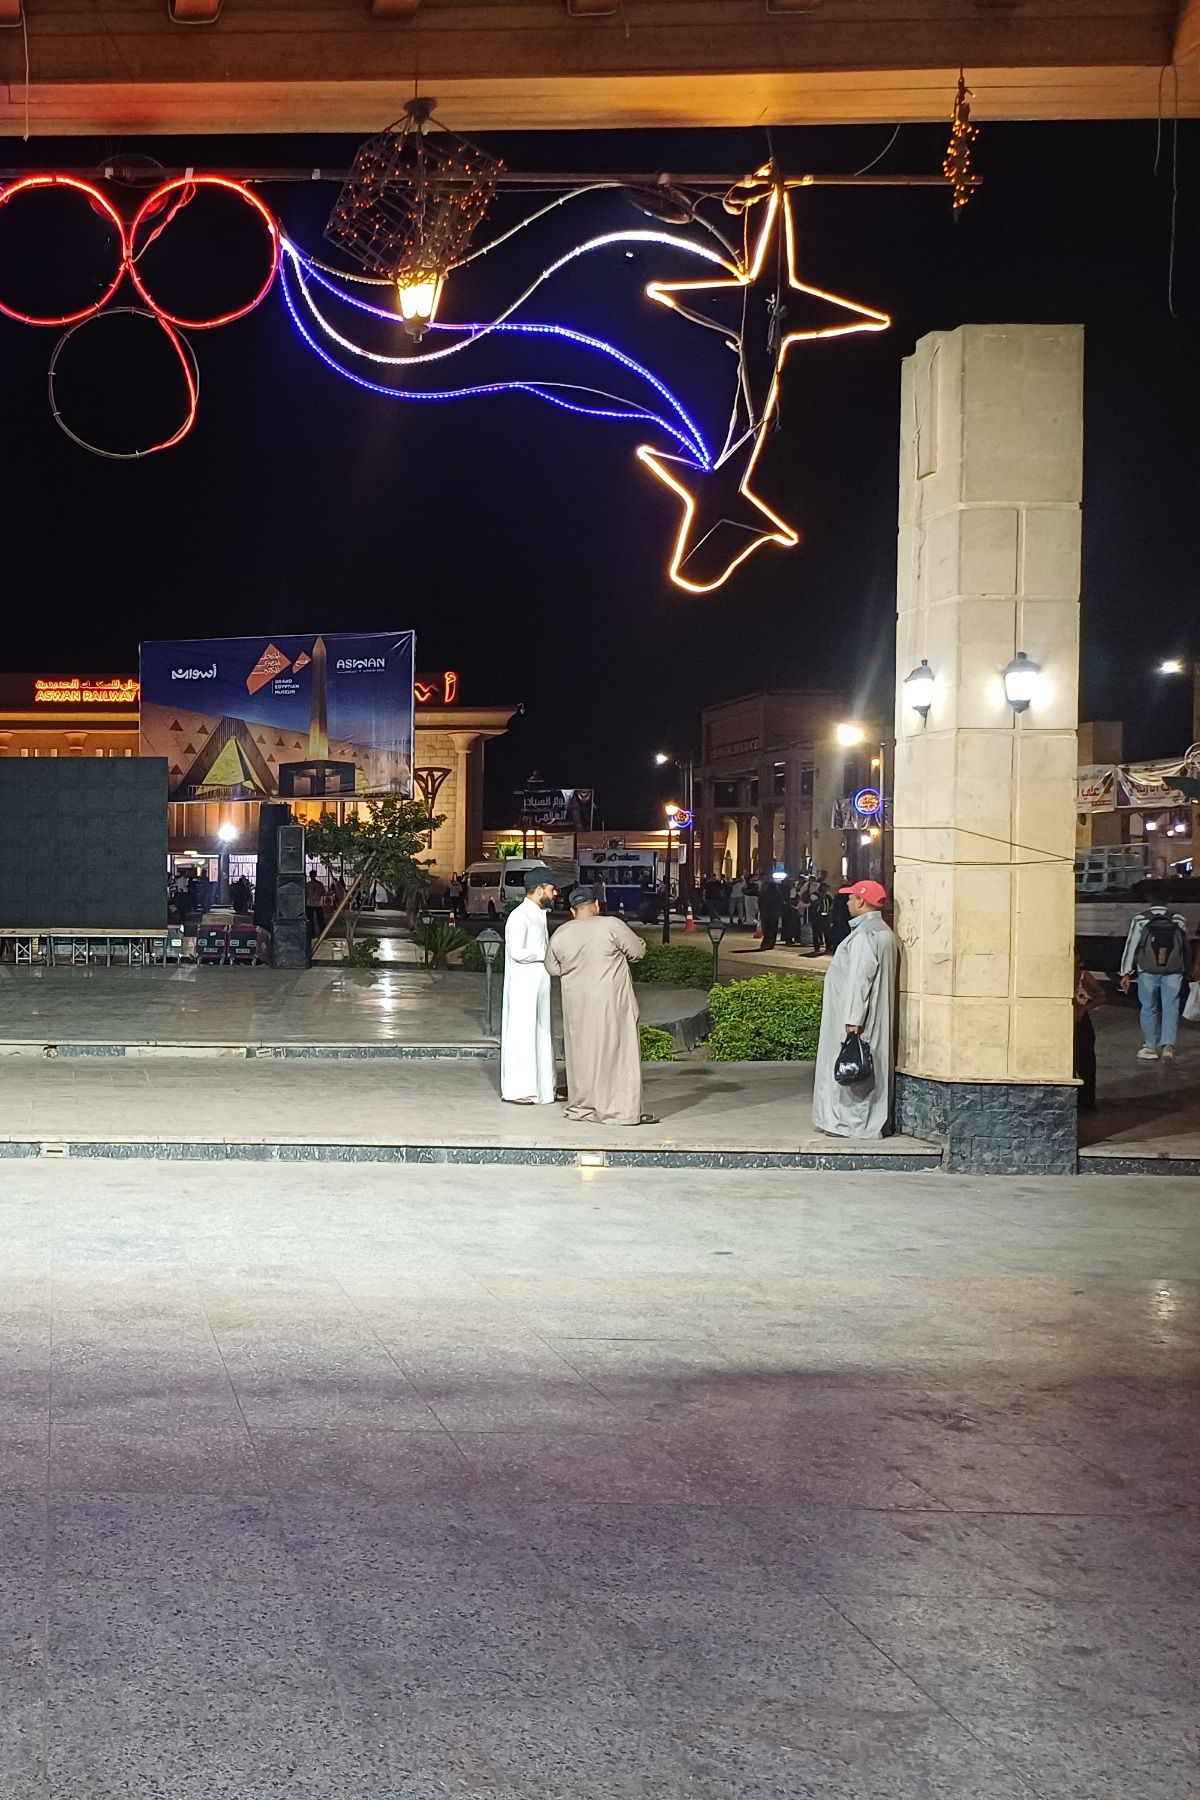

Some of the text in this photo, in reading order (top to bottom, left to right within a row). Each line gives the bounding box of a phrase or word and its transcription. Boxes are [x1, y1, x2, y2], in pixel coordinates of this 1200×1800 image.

[336, 658, 385, 669] ASWAN
[171, 663, 217, 680] أسوان
[35, 690, 80, 702] ASWAN
[82, 690, 137, 702] RAILWAY
